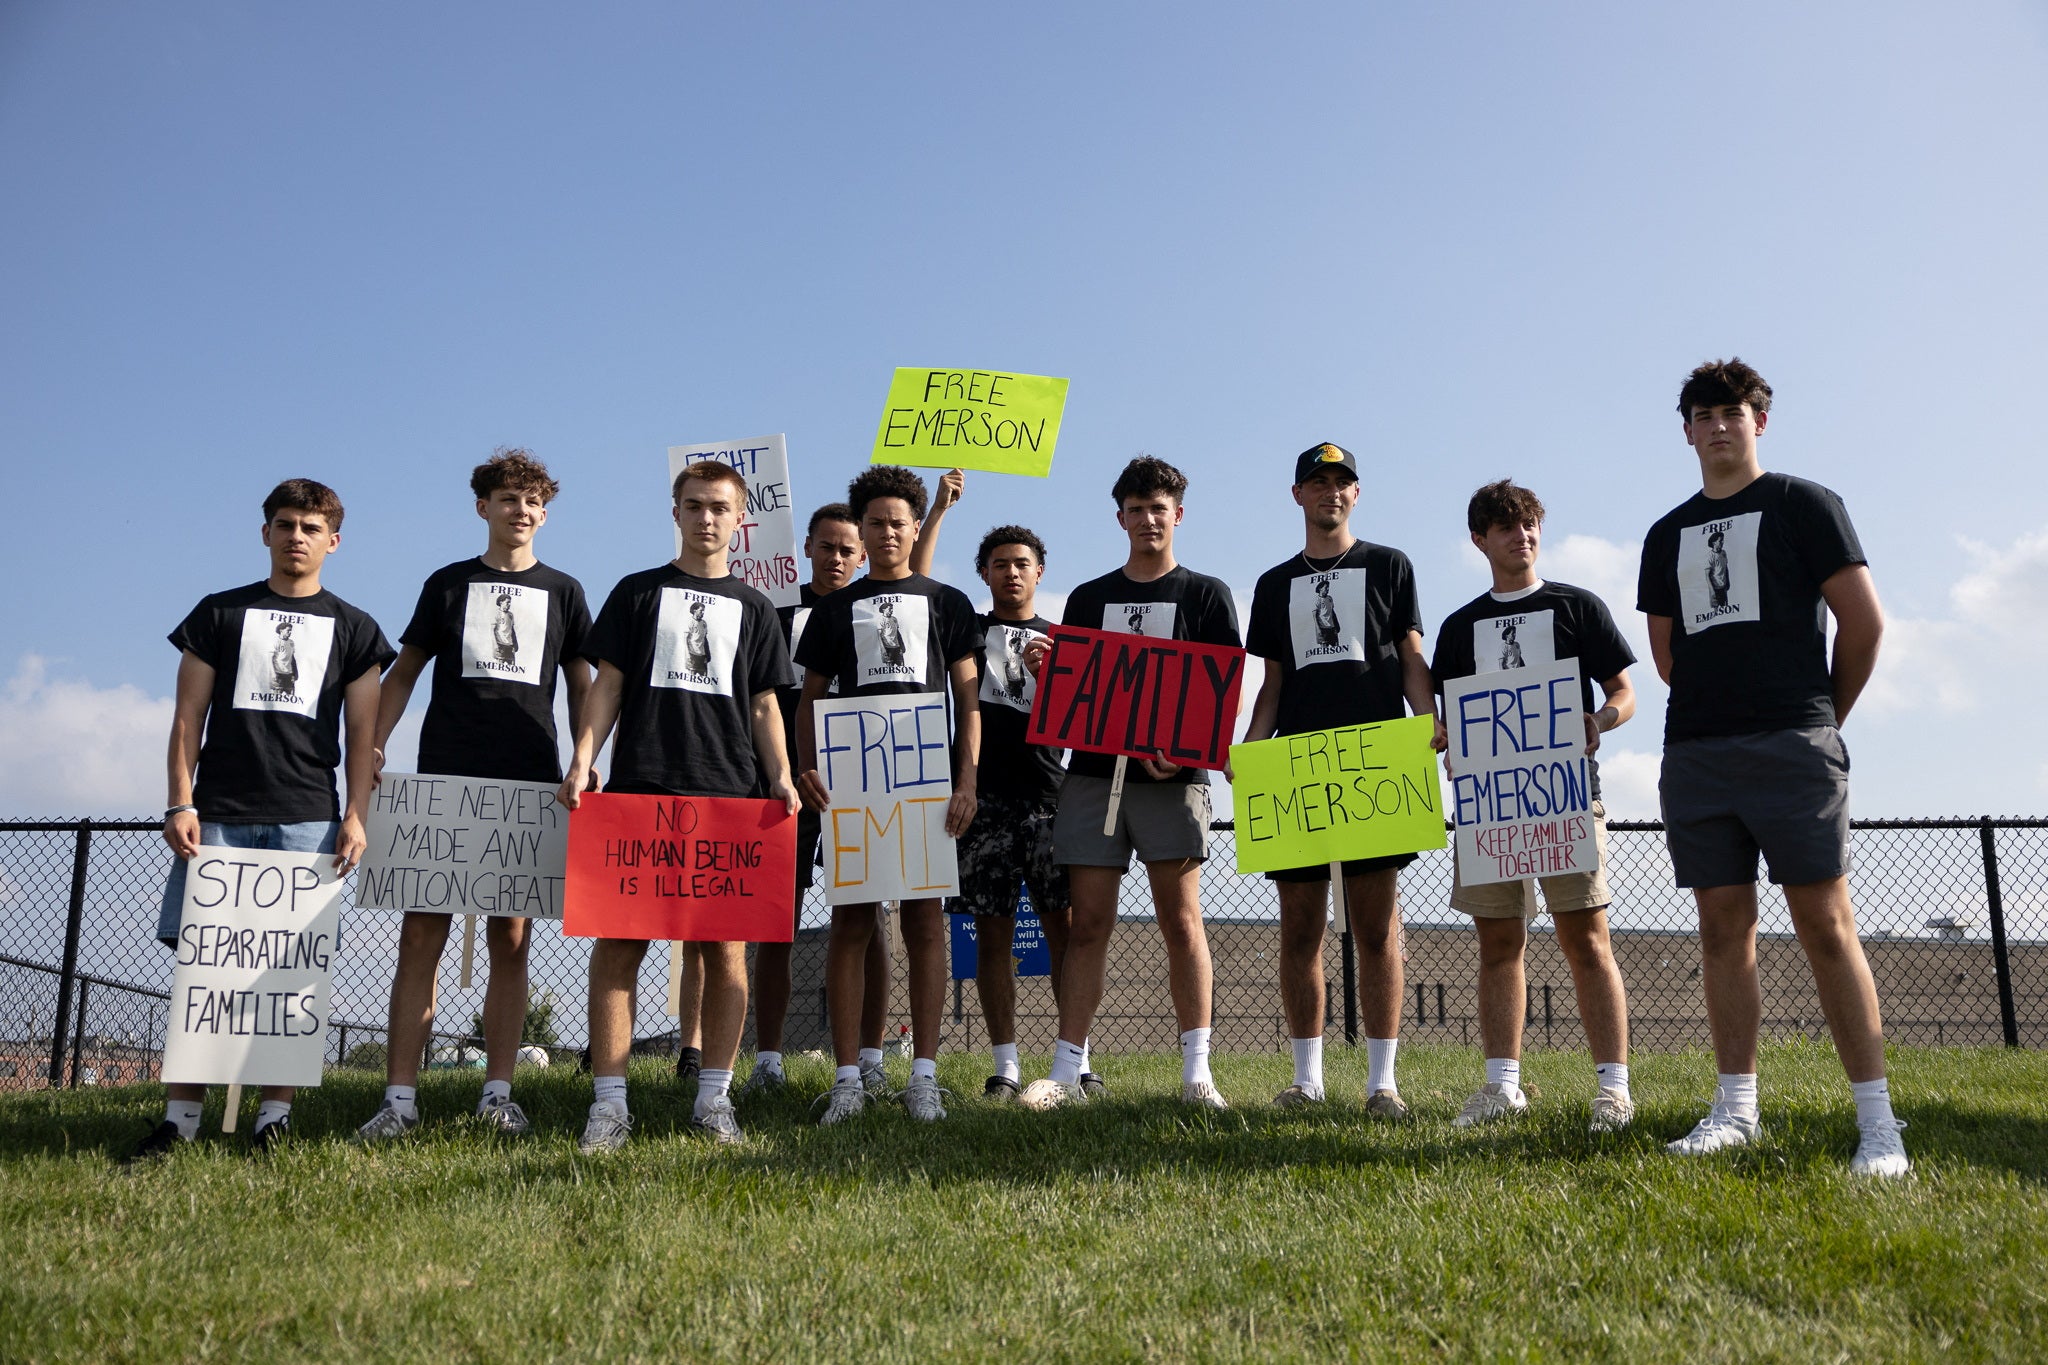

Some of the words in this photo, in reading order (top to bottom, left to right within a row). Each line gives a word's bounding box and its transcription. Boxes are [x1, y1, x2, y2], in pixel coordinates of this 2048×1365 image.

[924, 372, 1013, 406] FREE
[884, 409, 1045, 452] EMERSON
[1702, 520, 1733, 535] FREE
[490, 585, 522, 597] FREE
[1310, 572, 1339, 584] FREE
[684, 592, 716, 605] FREE
[872, 595, 902, 605] FREE
[1123, 605, 1152, 615] FREE
[270, 612, 305, 624] FREE
[1005, 628, 1032, 638] FREE
[1495, 616, 1526, 629] FREE
[475, 661, 526, 674] EMERSON
[1305, 645, 1350, 658] EMERSON
[667, 670, 719, 686] EMERSON
[868, 666, 915, 677] EMERSON
[250, 692, 304, 705] EMERSON
[1036, 633, 1241, 763] FAMILY
[1458, 677, 1575, 758] FREE
[820, 705, 949, 793] FREE
[1288, 726, 1388, 777] FREE
[377, 779, 446, 815] HATE
[459, 785, 557, 828] NEVER
[1248, 767, 1434, 841] EMERSON
[1453, 757, 1588, 826] EMERSON
[656, 800, 698, 834] NO
[388, 824, 470, 863] MADE
[479, 829, 542, 868] ANY
[831, 797, 952, 890] EMI
[1476, 825, 1518, 856] KEEP
[1522, 816, 1587, 849] FAMILIES
[605, 839, 686, 868] HUMAN
[695, 840, 763, 871] BEING
[1493, 844, 1577, 878] TOGETHER
[192, 859, 320, 911] STOP
[360, 867, 468, 909] NATION
[471, 872, 566, 915] GREAT
[620, 877, 638, 895] IS
[656, 874, 753, 898] ILLEGAL
[178, 924, 329, 972] SEPARATING
[1017, 930, 1035, 938] will
[185, 986, 320, 1036] FAMILIES
